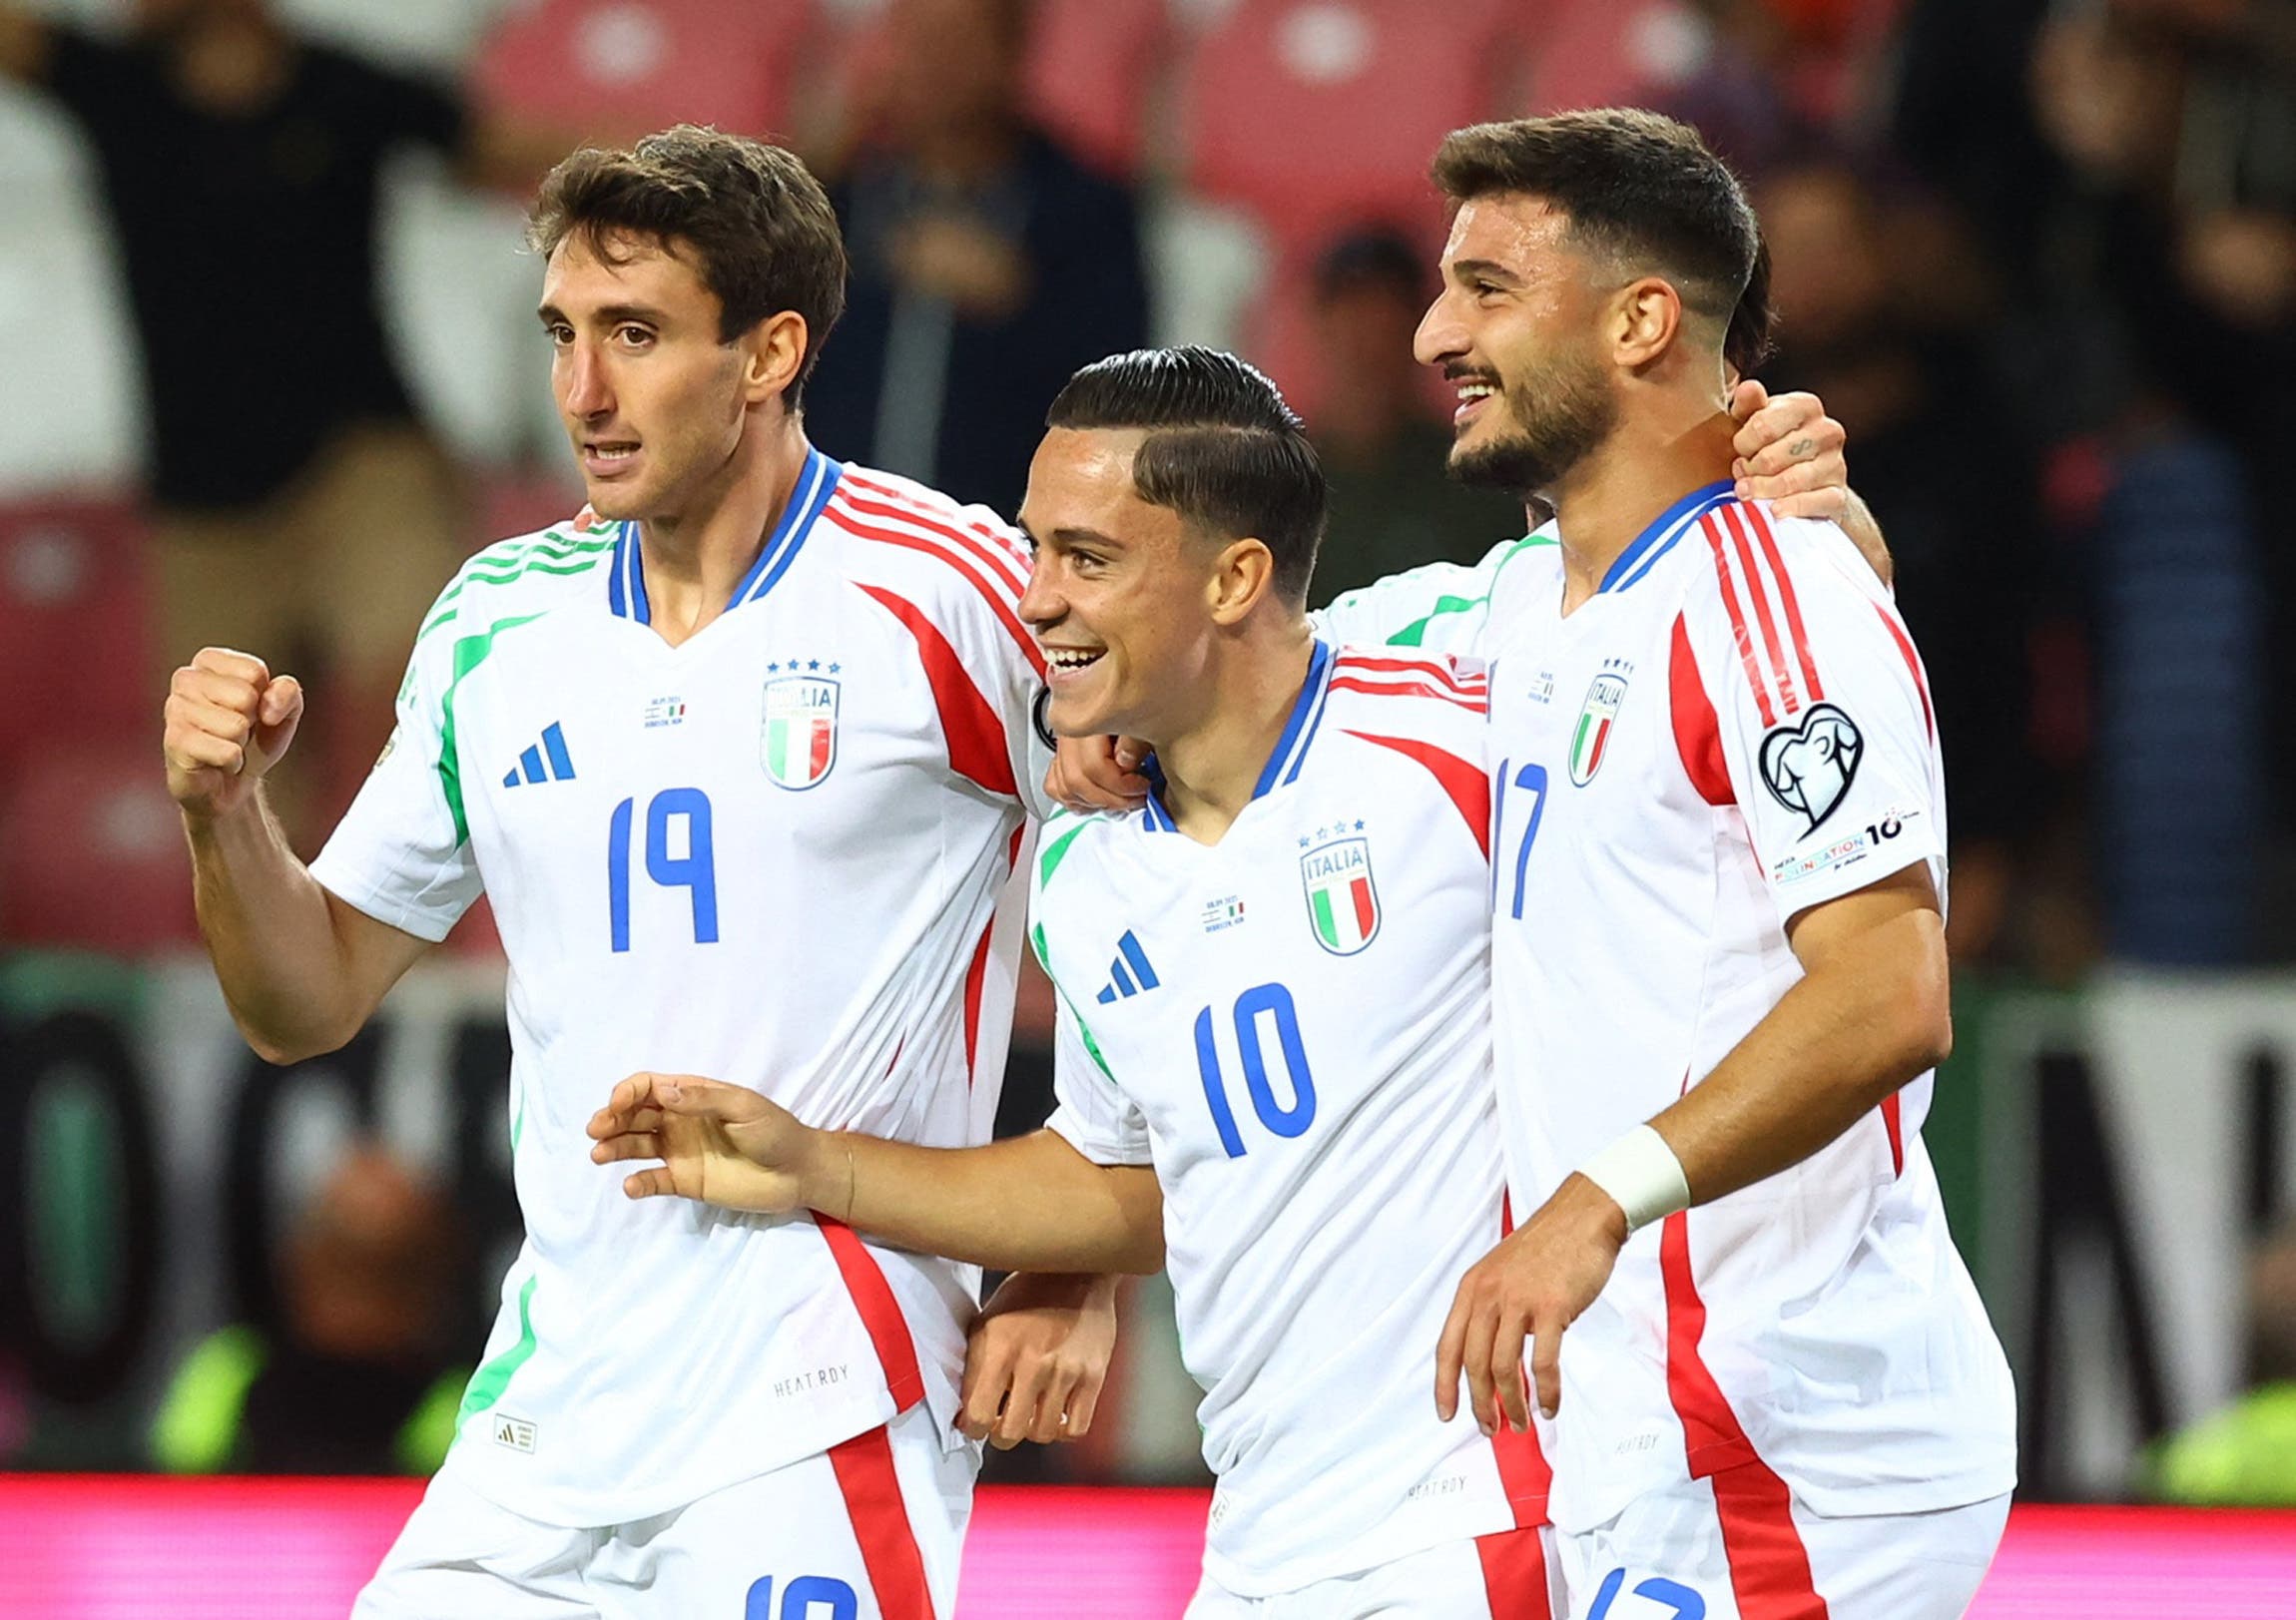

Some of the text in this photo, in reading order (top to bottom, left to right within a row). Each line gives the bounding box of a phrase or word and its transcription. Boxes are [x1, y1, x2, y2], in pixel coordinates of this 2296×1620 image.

[608, 787, 719, 953] 19
[1307, 845, 1364, 880] ITALIA
[1491, 757, 1548, 920] 17
[1865, 816, 1903, 846] 10
[1194, 981, 1317, 1159] 10
